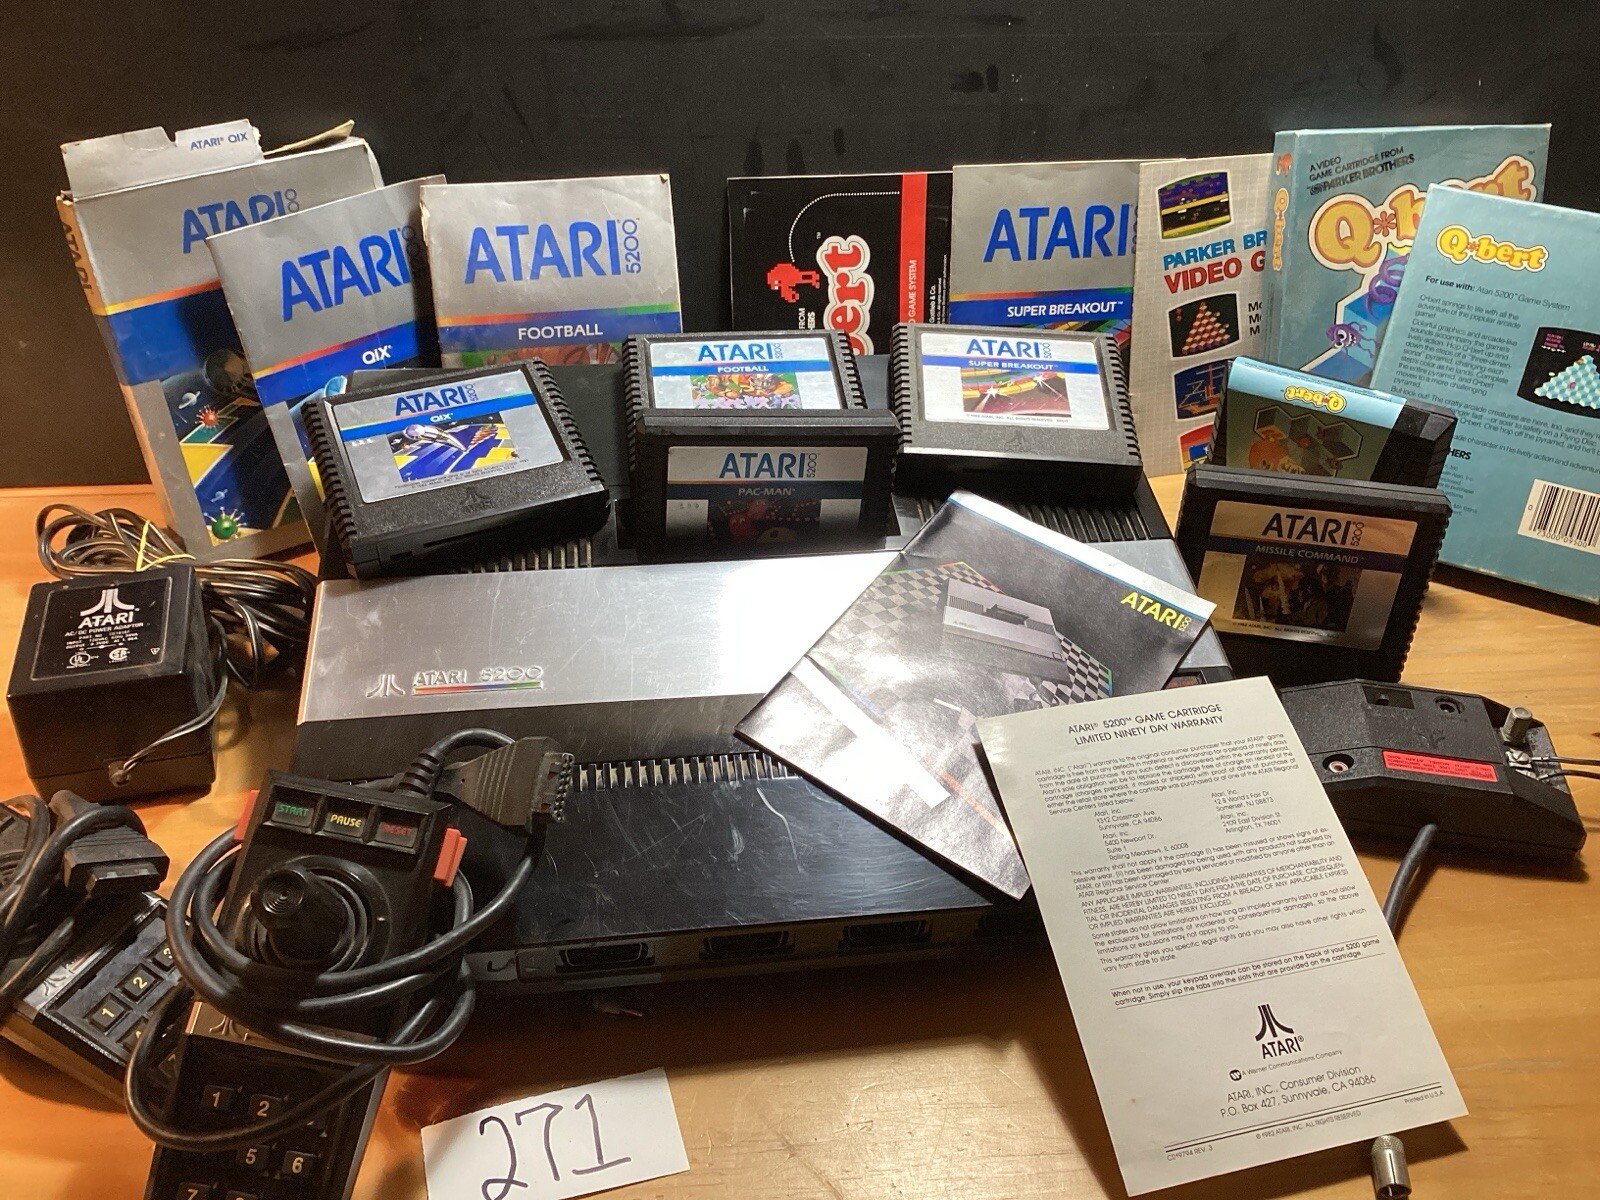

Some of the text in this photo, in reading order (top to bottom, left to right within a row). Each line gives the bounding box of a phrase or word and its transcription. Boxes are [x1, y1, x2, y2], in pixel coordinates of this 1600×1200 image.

[228, 132, 248, 144] QIX
[1309, 146, 1404, 182] GAME CARTRIDGE FROM
[1309, 156, 1342, 173] A VIDEO
[1322, 153, 1415, 192] PARKER BROTHERS
[983, 203, 1130, 263] ATARI
[464, 219, 621, 285] ATARI
[1163, 238, 1236, 271] PARKER
[281, 227, 411, 322] ATARI
[908, 259, 918, 290] SYSTEM
[1164, 256, 1243, 294] VIDEO
[907, 291, 917, 317] GAME
[1424, 274, 1439, 284] For
[1439, 279, 1455, 288] use
[1455, 282, 1475, 292] with:
[1517, 293, 1542, 306] Game
[1542, 298, 1571, 311] System
[798, 307, 806, 330] FROM
[1007, 305, 1046, 318] SUPER
[1484, 307, 1499, 317] with
[1507, 312, 1519, 321] the
[518, 323, 603, 341] FOOTBALL
[698, 342, 774, 362] ATARI
[966, 338, 1041, 359] ATARI
[717, 365, 769, 373] FOOTBALL
[968, 360, 999, 368] SUPER
[396, 384, 468, 416] ATARI
[719, 452, 806, 479] ATARI
[1261, 512, 1352, 546] ATARI
[1255, 544, 1359, 564] MISSILE COMMAND
[78, 611, 134, 629] ATARI
[1120, 591, 1184, 630] ATARI
[88, 626, 112, 634] POWER
[413, 665, 544, 686] ATARI 5200
[1134, 711, 1166, 724] GAME
[1166, 703, 1223, 719] CARTRIDGE
[1074, 714, 1223, 745] LIMITED NINETY DAY WARRANTY
[276, 802, 310, 817] START
[330, 814, 363, 828] PAUSE
[1110, 989, 1132, 998] When
[1131, 986, 1144, 994] not
[1166, 979, 1181, 989] your
[1181, 973, 1209, 984] keypad
[1208, 968, 1237, 979] overlays
[1236, 965, 1251, 974] can
[1250, 963, 1262, 971] be
[1261, 958, 1283, 969] stored
[1292, 954, 1305, 962] the
[1304, 950, 1323, 959] back
[1322, 947, 1330, 955] of
[1329, 945, 1345, 955] your
[1345, 941, 1361, 953] 5200
[1360, 938, 1380, 949] game
[1147, 989, 1170, 1000] Simply
[1170, 987, 1183, 995] slip
[1182, 985, 1195, 993] the
[1195, 982, 1211, 990] tabs
[1210, 979, 1225, 987] into
[1224, 976, 1237, 984] the
[1237, 973, 1252, 982] slots
[1251, 970, 1266, 978] that
[1266, 968, 1279, 976] are
[1278, 960, 1310, 974] provided
[1309, 959, 1320, 967] on
[133, 974, 148, 991] 2
[101, 1006, 115, 1020] 1
[1246, 1066, 1268, 1075] Warner
[1267, 1055, 1316, 1071] Communications
[1314, 1049, 1343, 1060] Company
[1279, 1073, 1325, 1091] Consumer
[1325, 1065, 1362, 1080] Division
[211, 1091, 270, 1117] 1 2
[1240, 1102, 1259, 1114] Box
[1331, 1080, 1348, 1092] CA
[1347, 1074, 1377, 1088] 94086
[1305, 1120, 1316, 1128] ALL
[1314, 1114, 1335, 1126] RIGHTS
[1333, 1109, 1362, 1121] RESERVED
[478, 1093, 632, 1200] 271
[245, 1148, 304, 1174] 5 6
